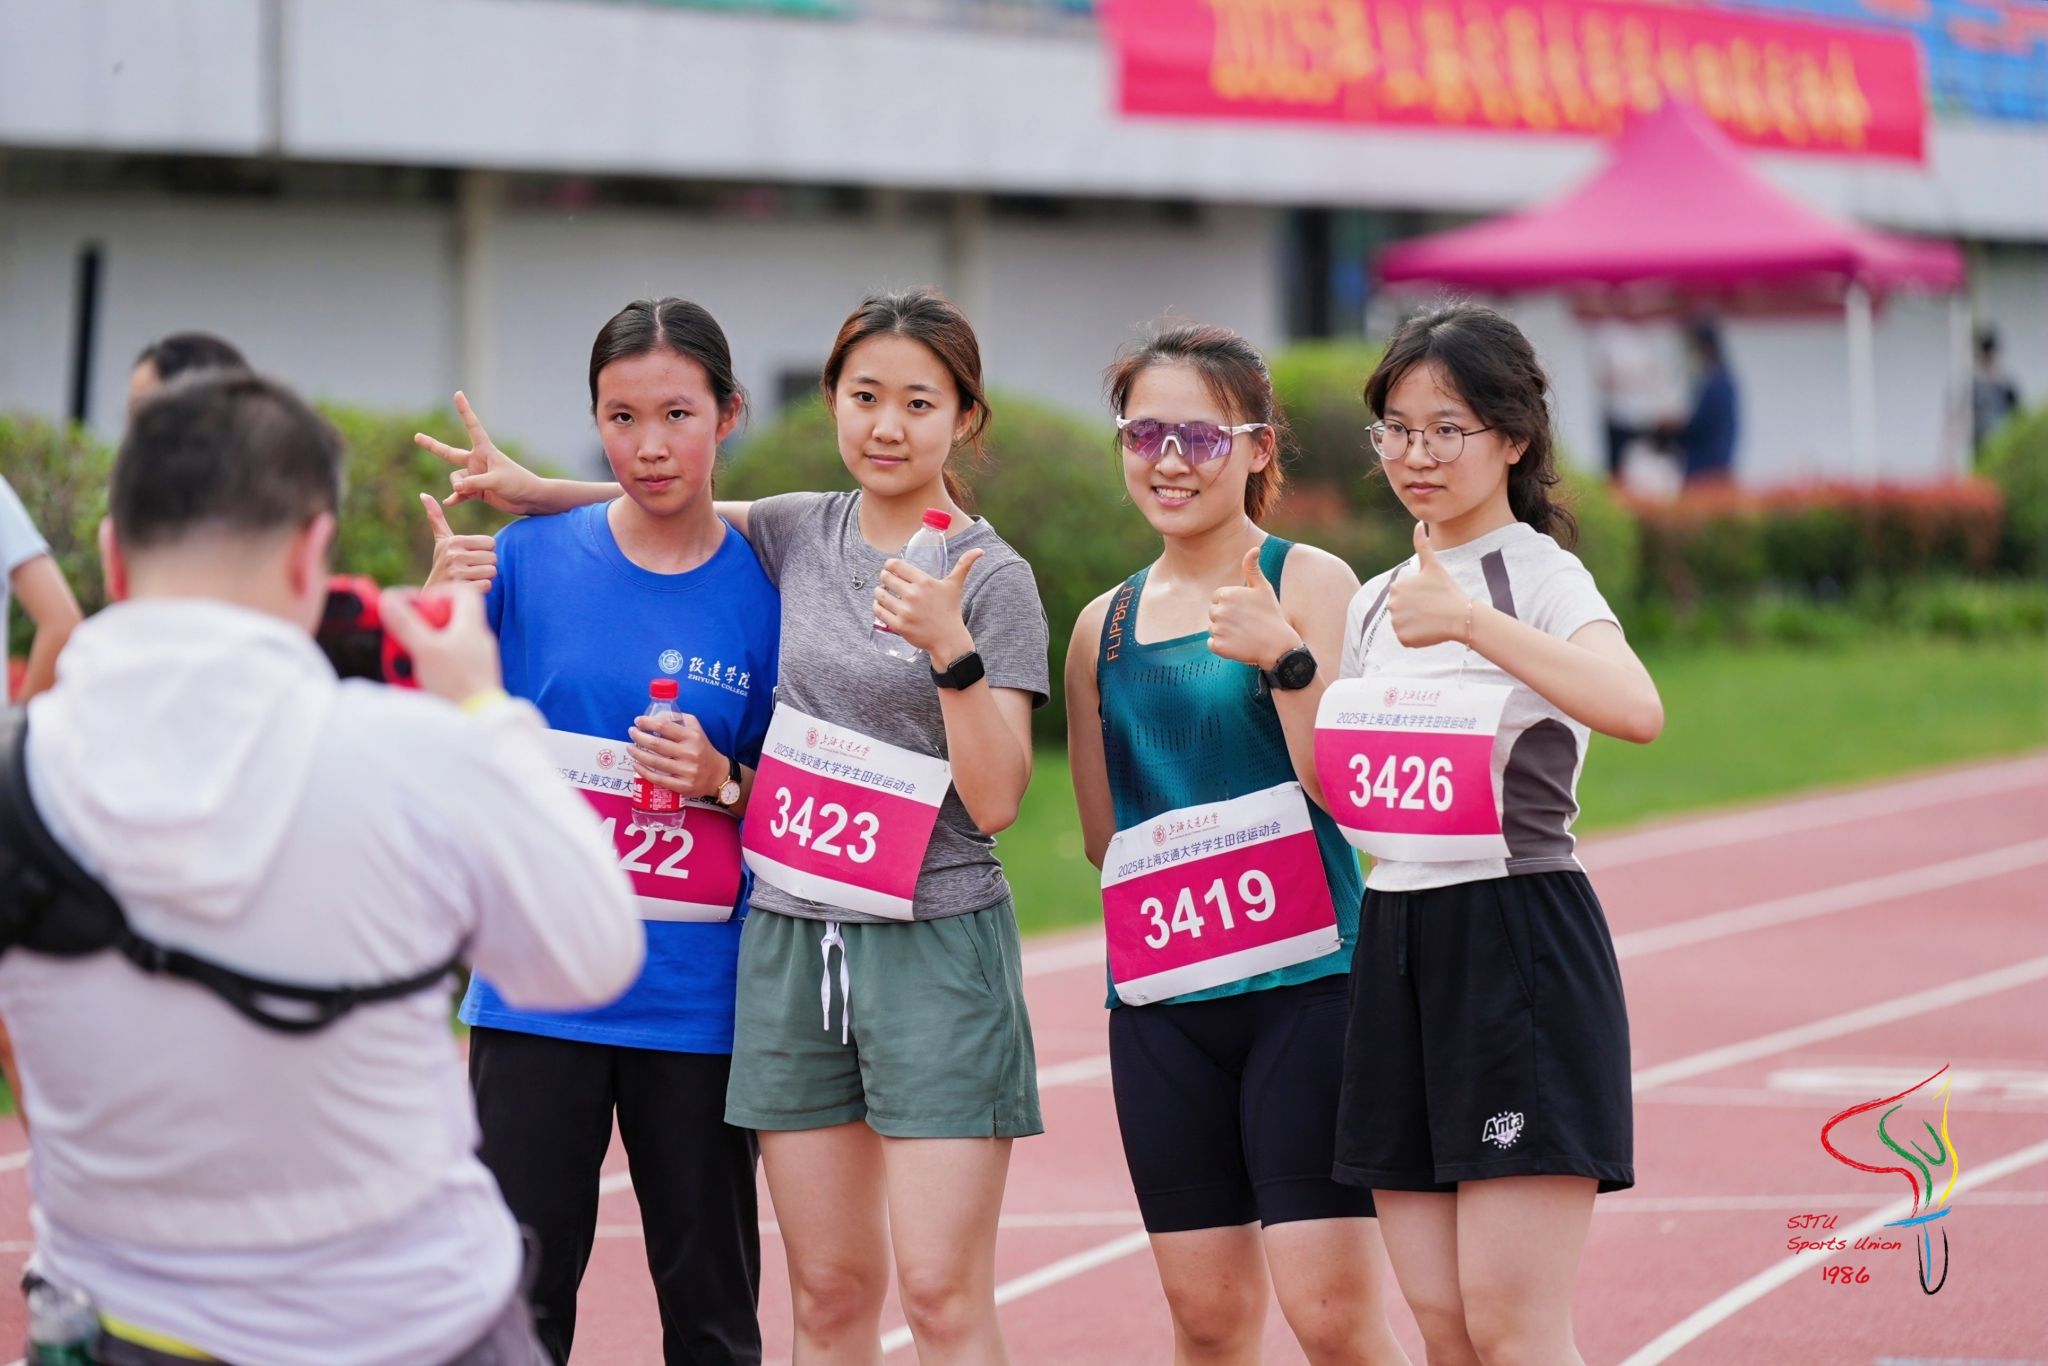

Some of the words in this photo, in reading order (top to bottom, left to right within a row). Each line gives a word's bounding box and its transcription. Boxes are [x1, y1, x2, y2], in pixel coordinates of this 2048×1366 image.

[1107, 586, 1136, 662] FLIPBELT
[687, 673, 720, 687] ZHIYUAN
[721, 682, 749, 697] COLLEGE
[1336, 711, 1478, 730] 2025年上海交通大学学生田径运动会
[773, 742, 917, 795] 2025年上海交通大学学生田径运动会
[1348, 753, 1454, 812] 3426
[769, 786, 880, 864] 3423
[1117, 820, 1282, 878] 2025年上海交通大学学生田径运动会
[1140, 868, 1277, 950] 3419
[1482, 1112, 1525, 1143] Anta
